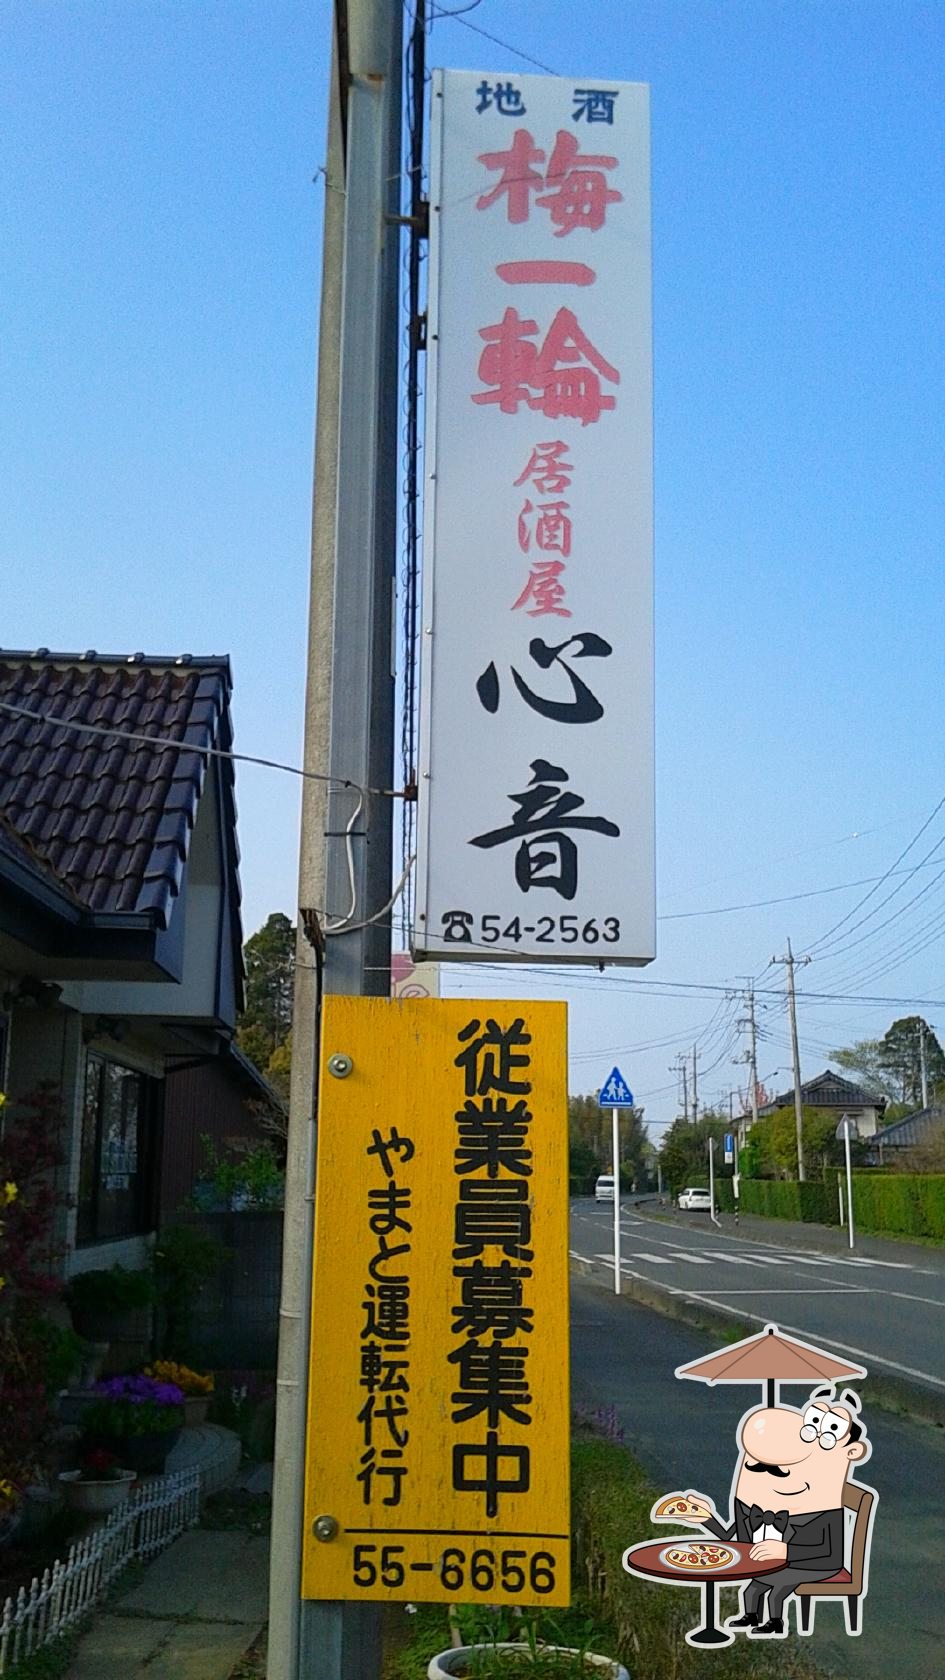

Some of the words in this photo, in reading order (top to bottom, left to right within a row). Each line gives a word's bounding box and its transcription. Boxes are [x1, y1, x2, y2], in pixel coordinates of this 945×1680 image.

[471, 128, 623, 427] 梅一輪
[512, 440, 575, 618] 居酒屋
[467, 632, 620, 901] 心音
[481, 915, 620, 944] 54-2563
[356, 1126, 416, 1506] やまと運転代行
[448, 1018, 534, 1518] 従業員募集中
[353, 1544, 556, 1593] 55-6656
